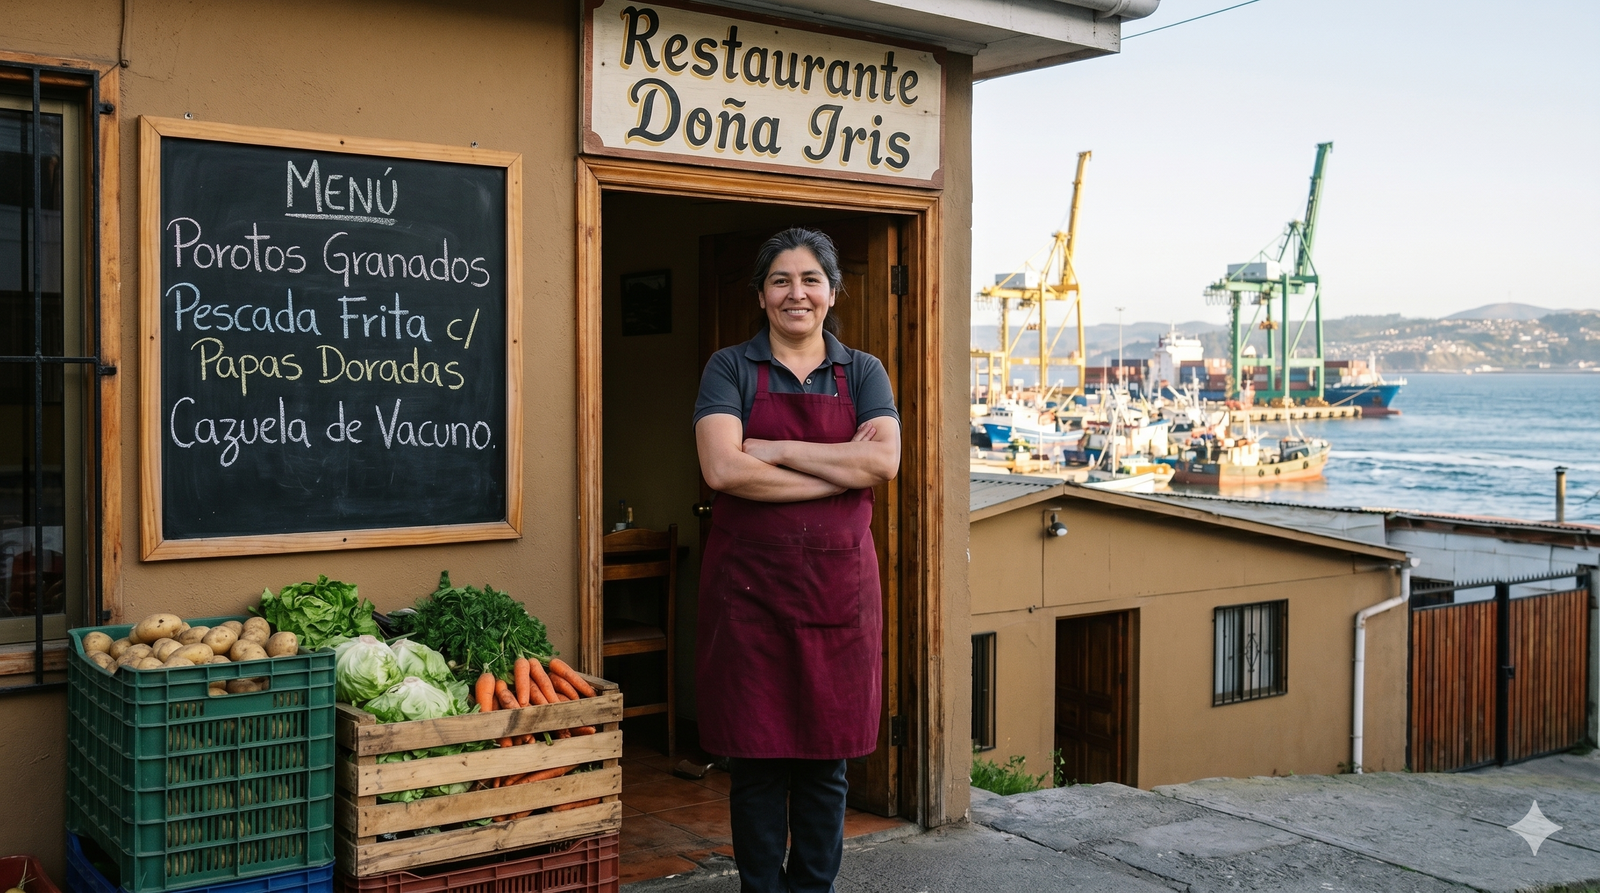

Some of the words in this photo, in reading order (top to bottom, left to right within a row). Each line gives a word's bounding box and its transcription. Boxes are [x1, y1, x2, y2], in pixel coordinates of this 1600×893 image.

[621, 5, 919, 106] Restaurante
[626, 77, 782, 158] Doña
[803, 104, 911, 172] Iris
[286, 159, 398, 215] MENÚ
[166, 217, 306, 274] Porotos
[323, 231, 490, 288] Granados
[165, 282, 322, 337] Pescada
[338, 292, 432, 342] Frita
[446, 308, 480, 350] c/
[191, 337, 303, 396] Papas
[316, 344, 466, 391] Doradas
[170, 397, 312, 467] Cazuela
[325, 401, 363, 444] de
[375, 398, 496, 450] Vacuno.
